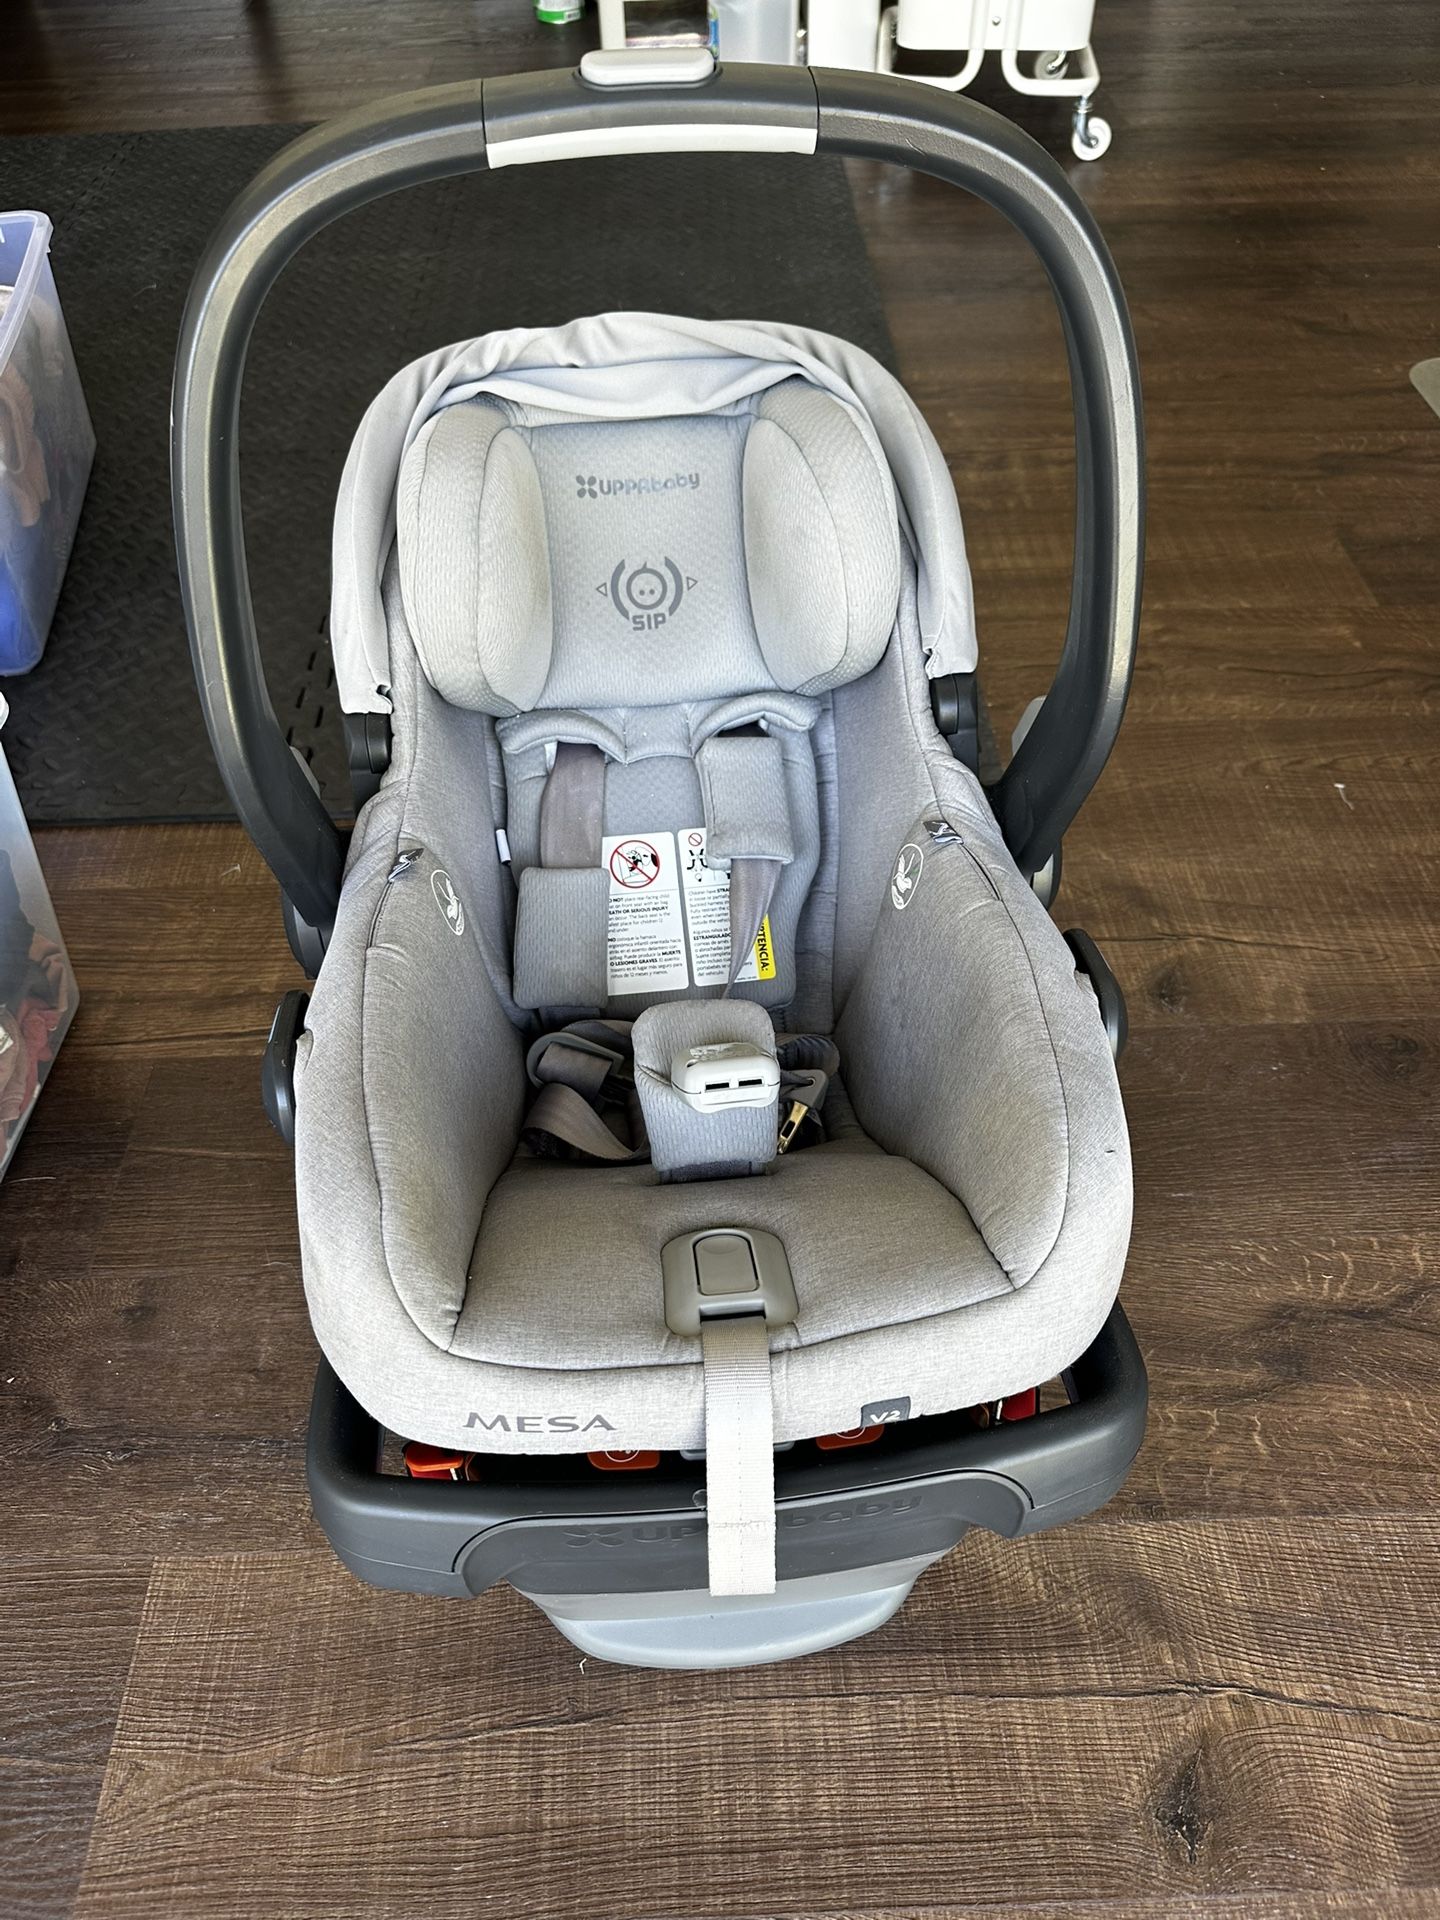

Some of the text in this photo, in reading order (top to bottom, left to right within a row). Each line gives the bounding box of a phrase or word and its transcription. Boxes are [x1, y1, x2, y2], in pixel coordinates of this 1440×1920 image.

[632, 613, 666, 631] SIP
[462, 1412, 618, 1433] MESA
[870, 1410, 900, 1423] V2
